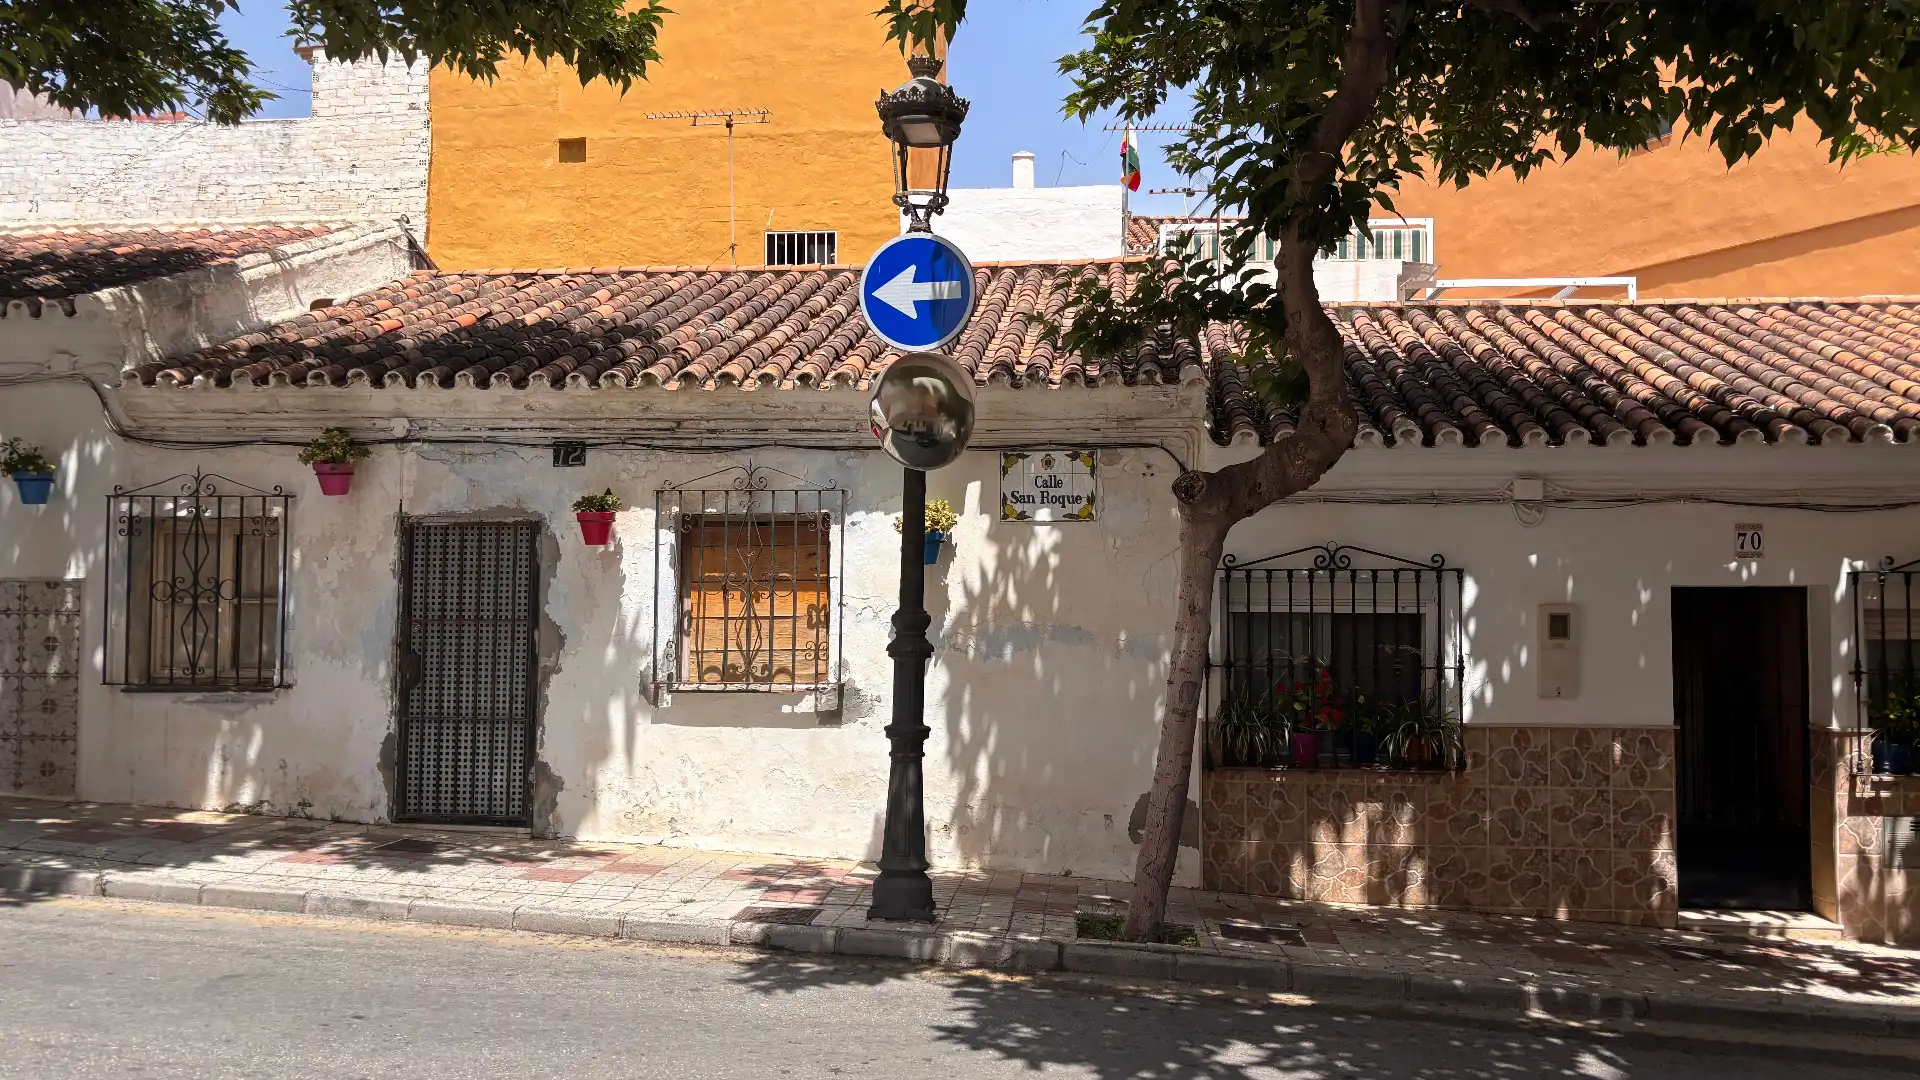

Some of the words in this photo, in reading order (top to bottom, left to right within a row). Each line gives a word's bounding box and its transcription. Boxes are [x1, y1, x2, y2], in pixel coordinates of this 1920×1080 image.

[1034, 474, 1063, 489] Calle
[1010, 490, 1036, 504] San
[1039, 490, 1083, 508] Roque
[1737, 531, 1761, 550] 70
